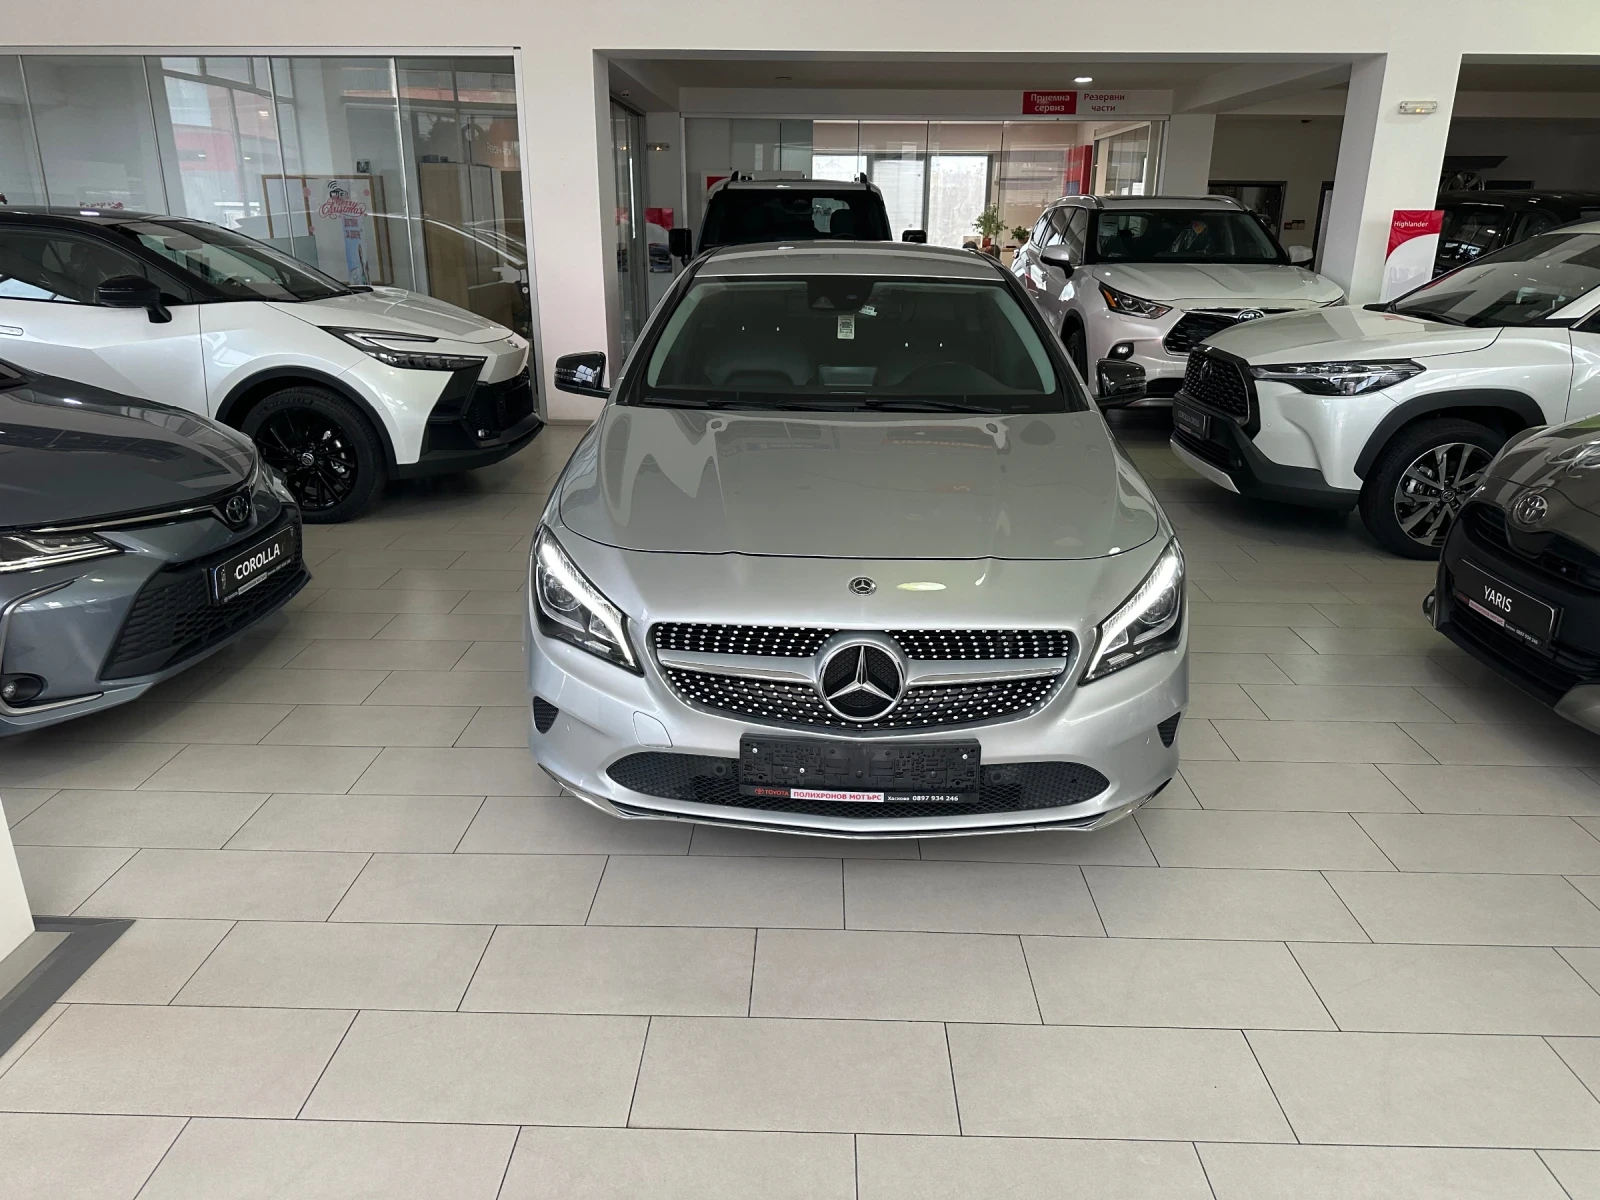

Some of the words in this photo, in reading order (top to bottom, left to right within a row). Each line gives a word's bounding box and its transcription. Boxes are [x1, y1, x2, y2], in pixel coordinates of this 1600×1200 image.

[1030, 93, 1070, 104] Приемна
[1083, 93, 1125, 103] Резервни
[1034, 104, 1065, 113] сервиз
[1091, 104, 1116, 112] части
[1393, 220, 1429, 229] Highlander
[235, 543, 280, 580] COROLLA
[1484, 585, 1513, 613] YARIS
[793, 791, 848, 800] ПОЛИХРОНОВ
